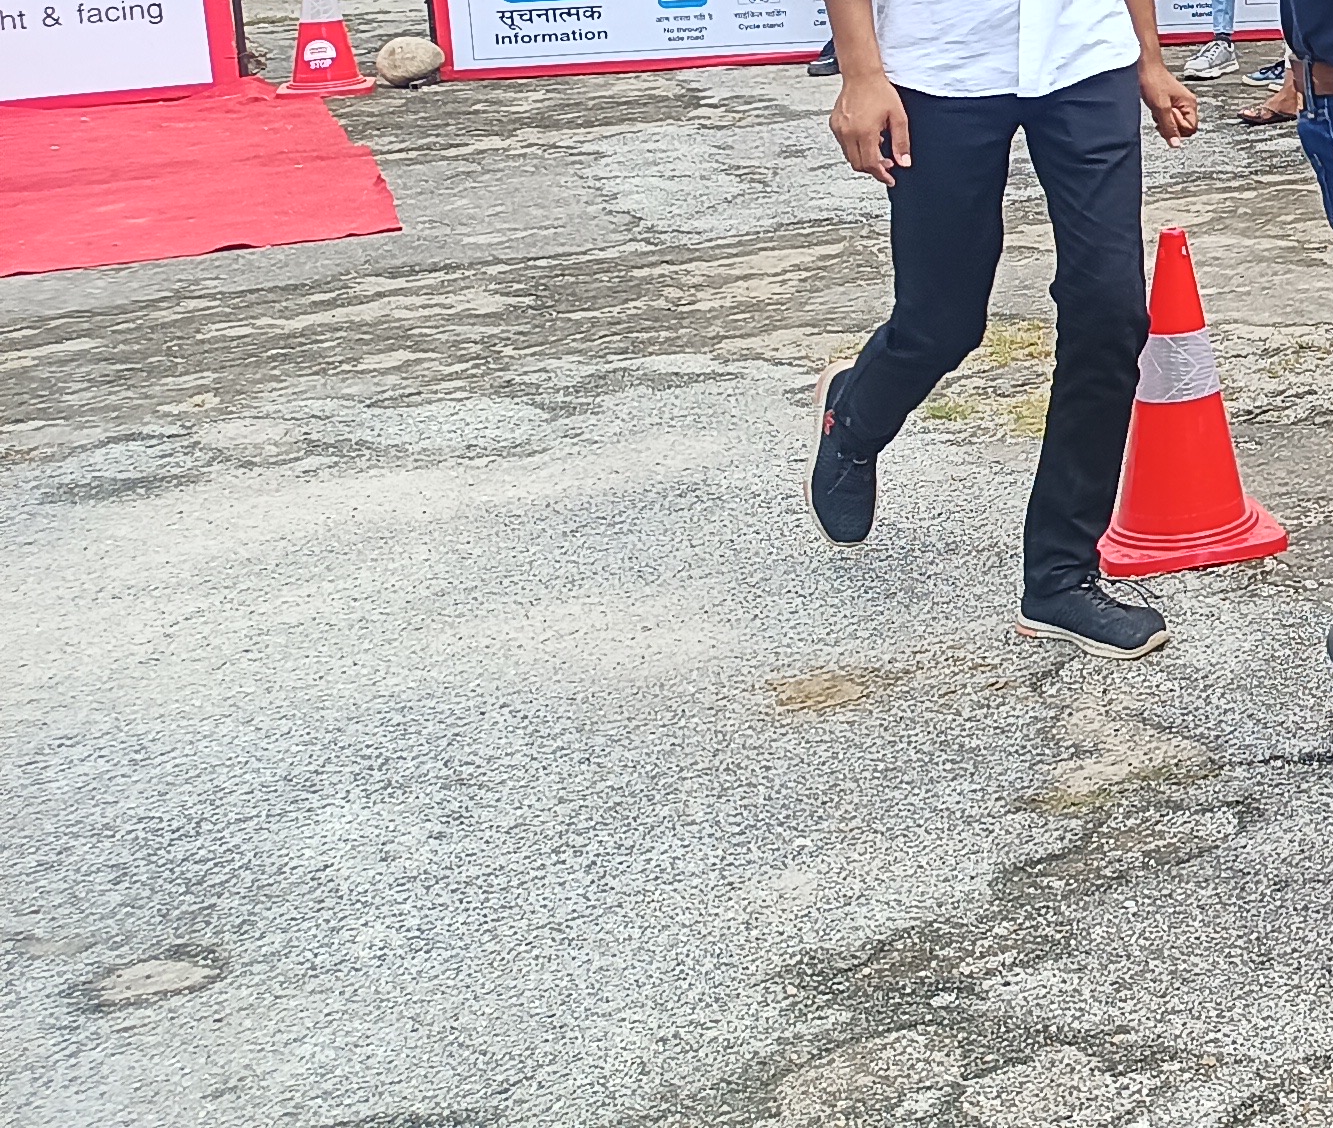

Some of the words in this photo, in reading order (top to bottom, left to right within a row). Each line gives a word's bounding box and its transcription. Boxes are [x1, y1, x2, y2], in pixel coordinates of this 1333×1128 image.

[42, 6, 62, 28] &
[77, 0, 163, 25] facing
[496, 6, 602, 31] सूचनात्मक
[495, 29, 608, 45] Information
